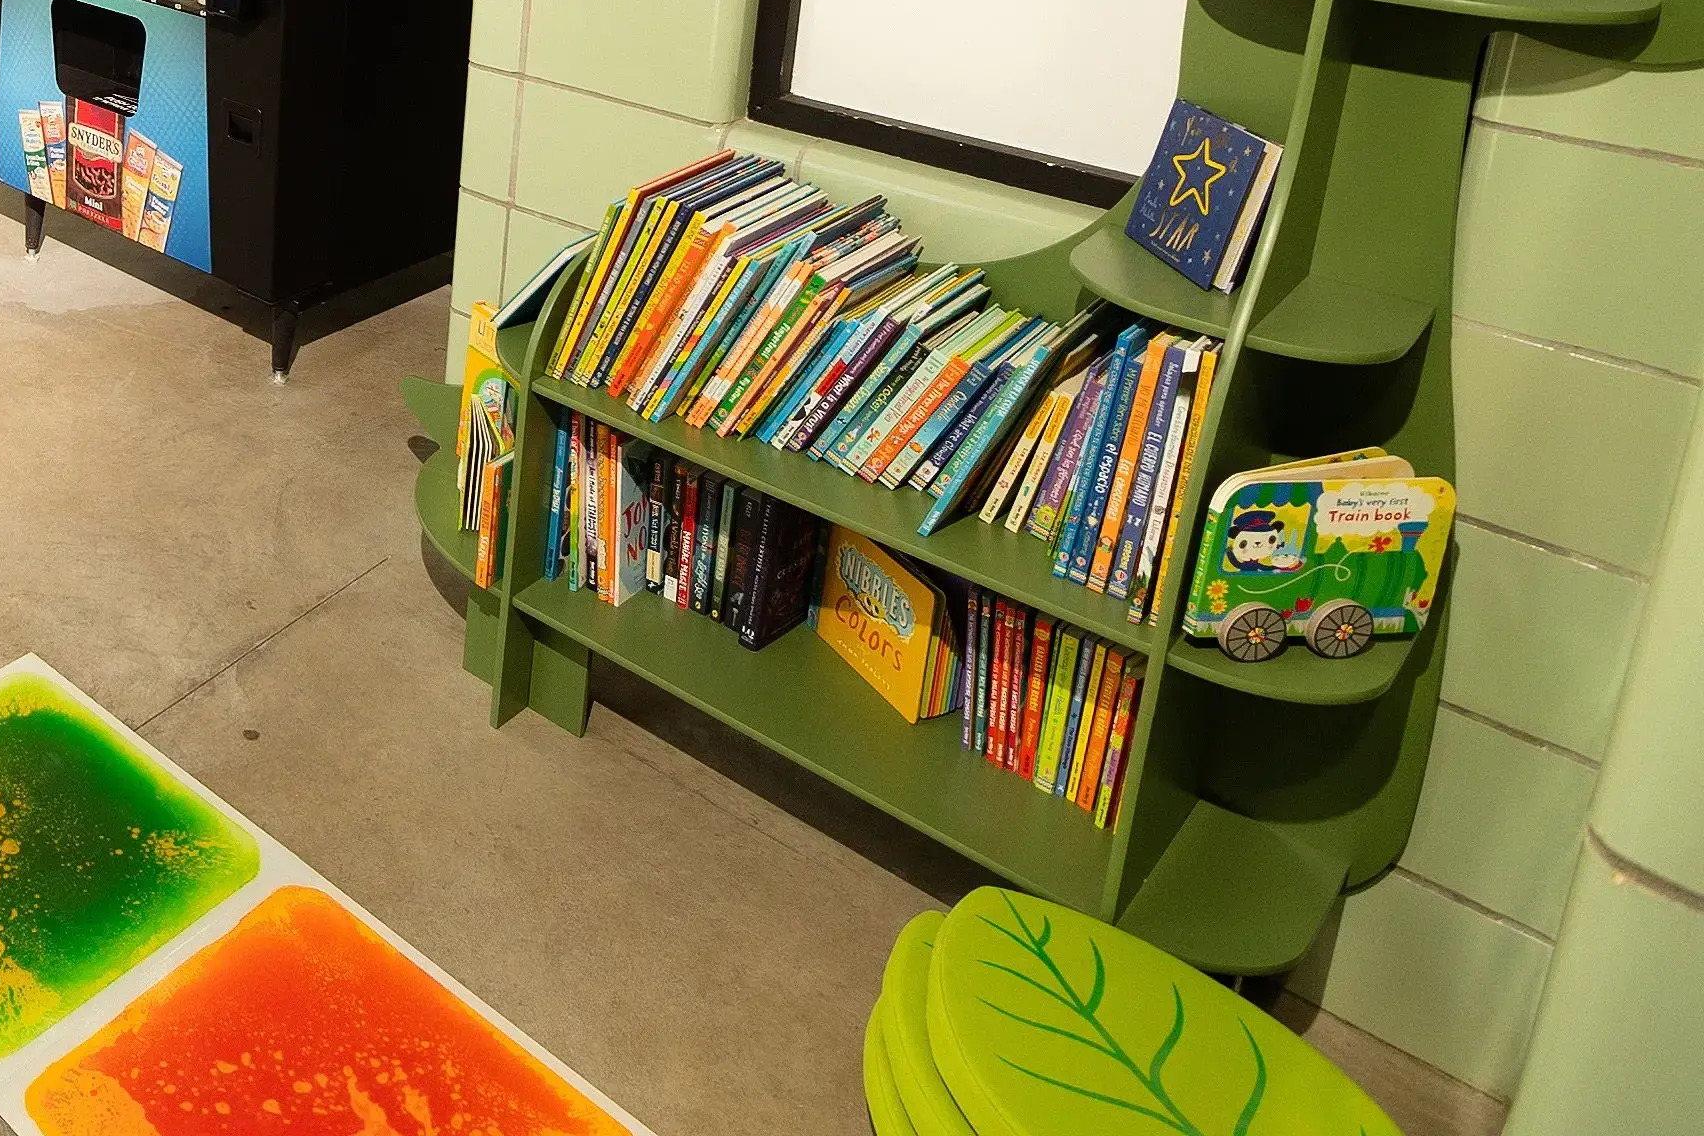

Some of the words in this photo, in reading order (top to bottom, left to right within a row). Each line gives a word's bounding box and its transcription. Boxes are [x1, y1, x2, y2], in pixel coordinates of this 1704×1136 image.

[71, 127, 120, 156] SNYDER'S
[84, 196, 104, 212] Mini
[831, 371, 853, 396] What
[957, 411, 977, 432] What
[948, 427, 963, 443] are
[1146, 431, 1163, 443] EL
[930, 439, 955, 467] Clouds?
[1105, 443, 1119, 455] el
[1139, 443, 1160, 473] CUERPO
[1094, 455, 1115, 494] espacio
[1131, 471, 1153, 507] HUMANO
[1366, 499, 1386, 508] very
[1388, 497, 1408, 506] first
[1328, 510, 1370, 522] Train
[1374, 508, 1412, 522] book
[845, 552, 910, 628] NIBBLES
